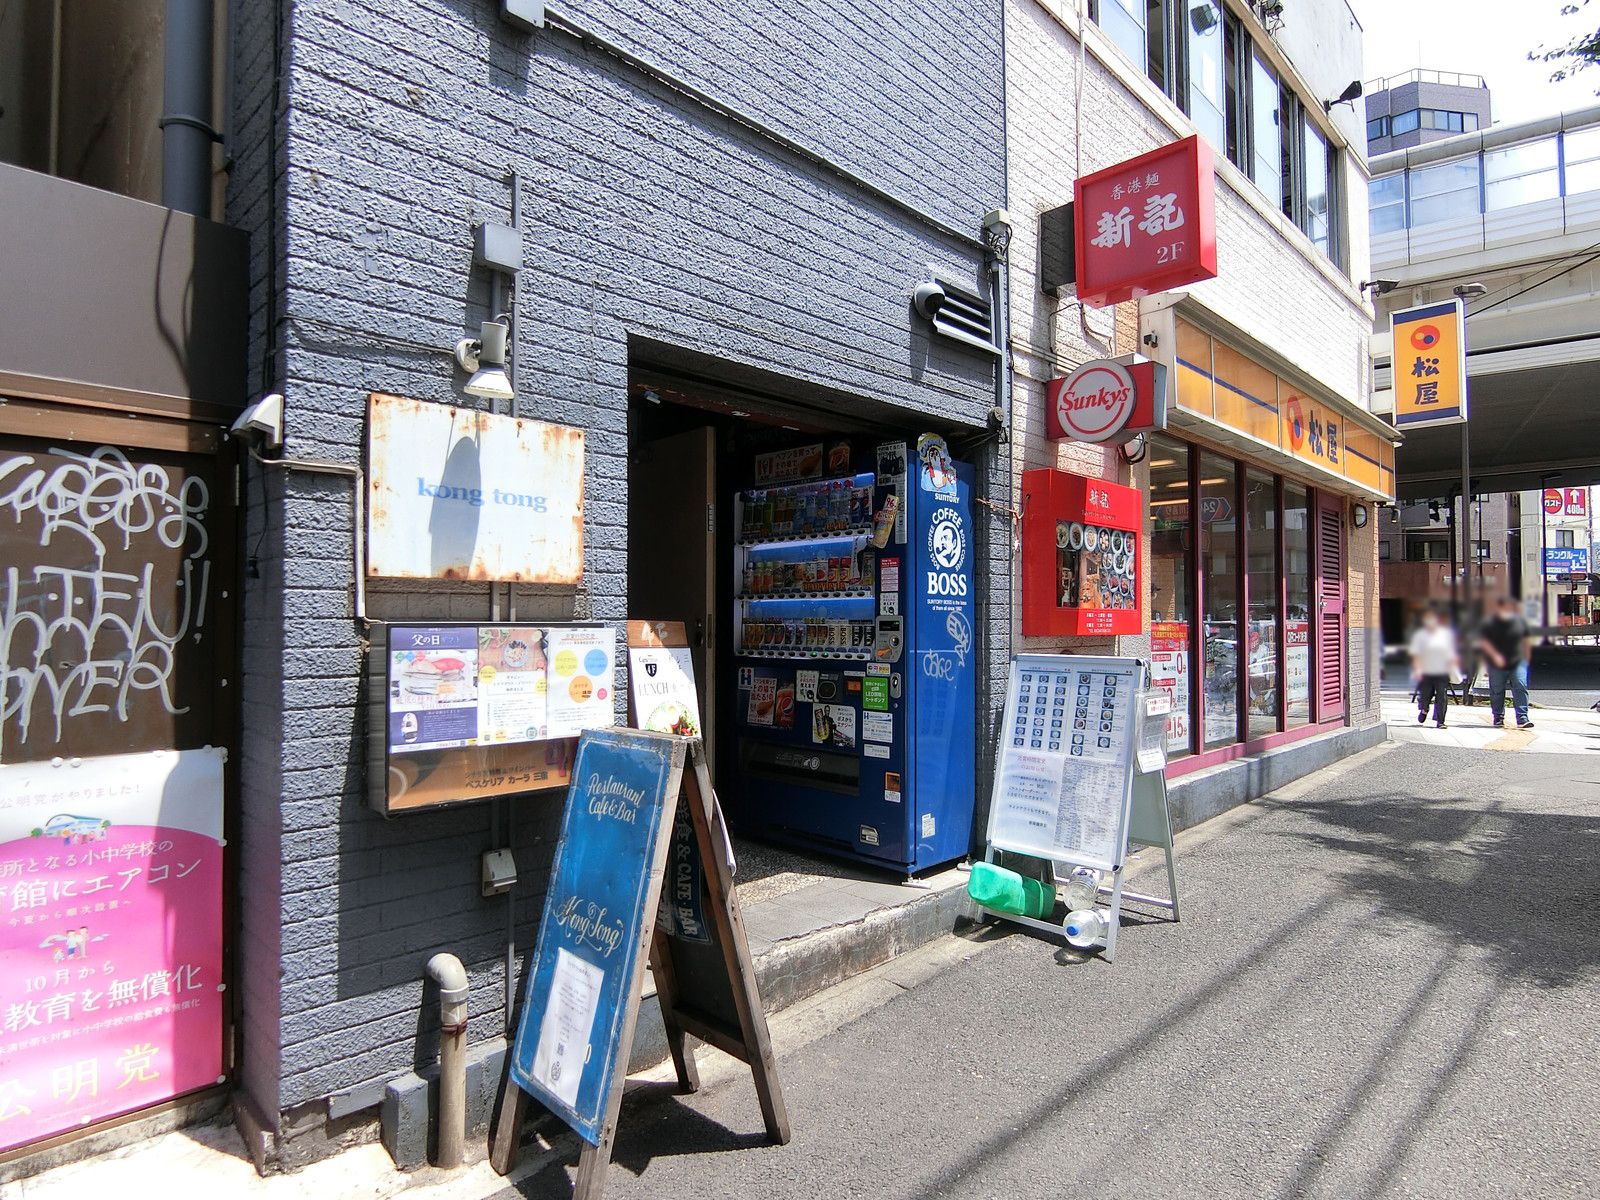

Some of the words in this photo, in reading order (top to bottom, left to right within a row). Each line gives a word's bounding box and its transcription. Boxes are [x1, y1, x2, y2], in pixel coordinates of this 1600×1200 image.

[1090, 192, 1185, 248] 新記
[1157, 241, 1185, 265] 2F
[1411, 356, 1440, 405] 松屋
[1059, 386, 1131, 412] Sunkys
[1308, 410, 1339, 465] 松屋
[417, 477, 484, 507] kong
[492, 488, 549, 513] tong
[932, 507, 963, 529] COFFEE
[928, 524, 936, 552] COFFEE
[927, 572, 967, 596] BOSS
[587, 773, 646, 808] Restaurant
[25, 960, 115, 993] 10月から
[0, 964, 203, 1035] 教育を無償化
